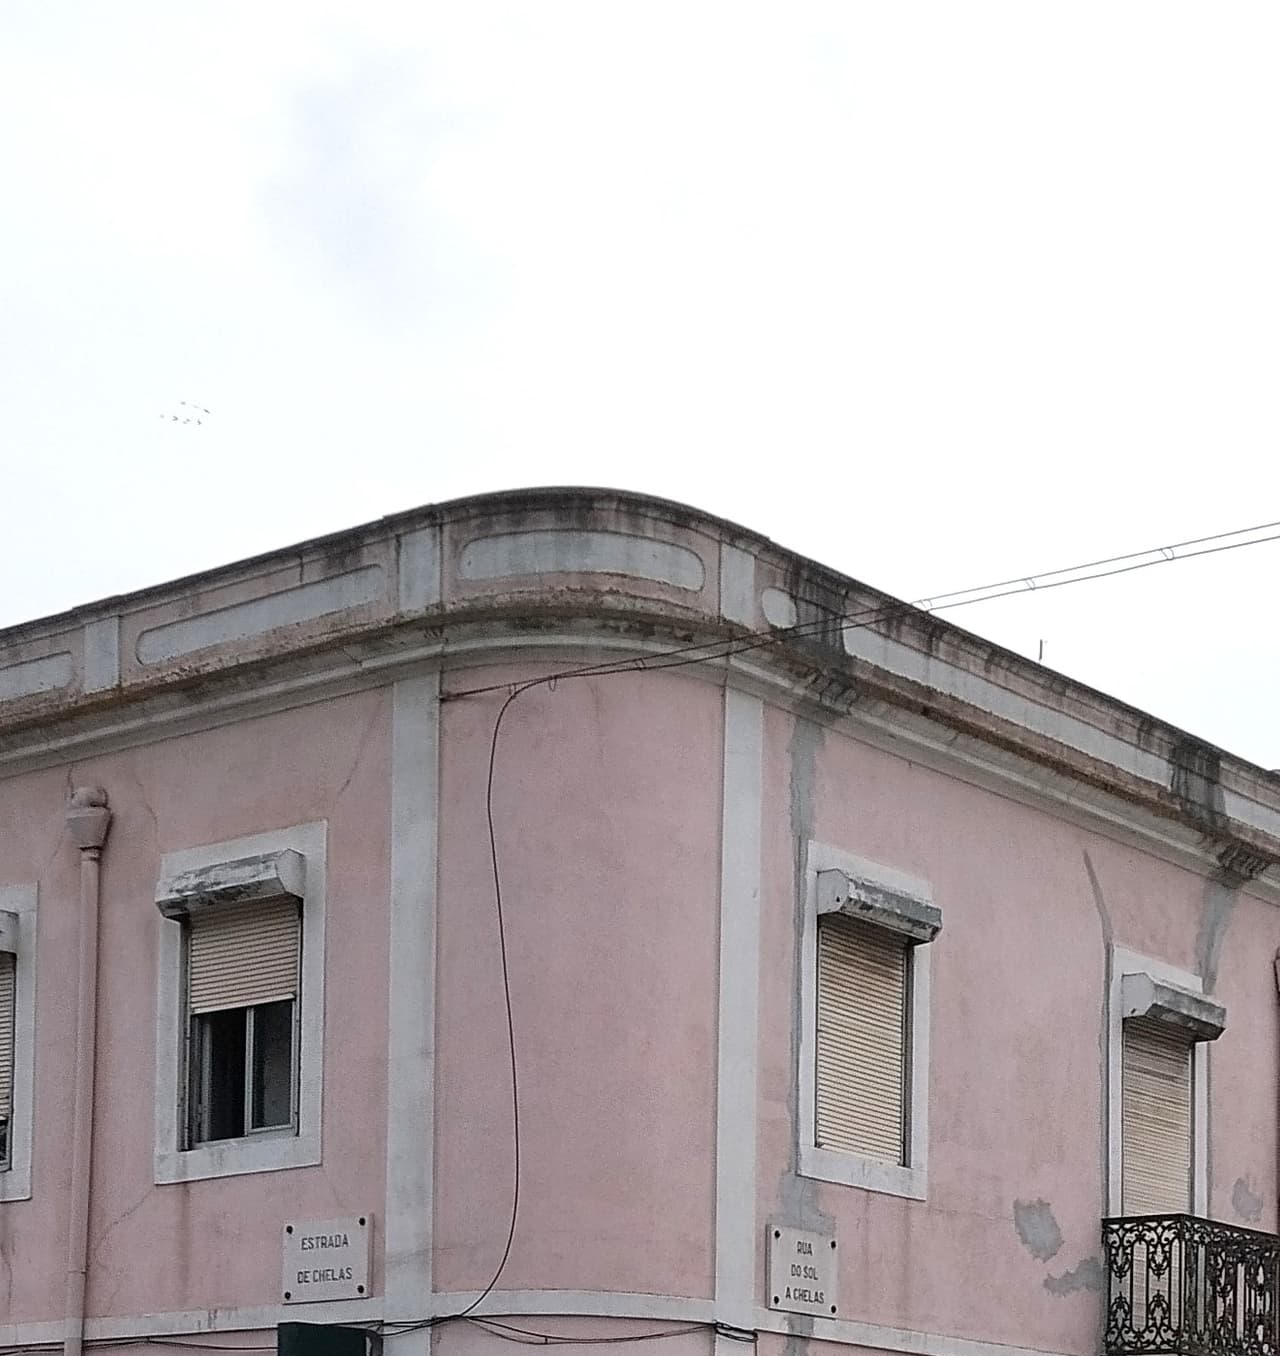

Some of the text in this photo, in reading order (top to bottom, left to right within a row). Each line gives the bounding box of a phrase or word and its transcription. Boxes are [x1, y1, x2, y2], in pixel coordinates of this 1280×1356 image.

[301, 1234, 348, 1250] ESTRADA
[797, 1241, 813, 1256] RUA
[297, 1267, 352, 1284] DE CHELAS
[791, 1264, 818, 1280] DO SOL
[793, 1288, 824, 1304] CHELAS
